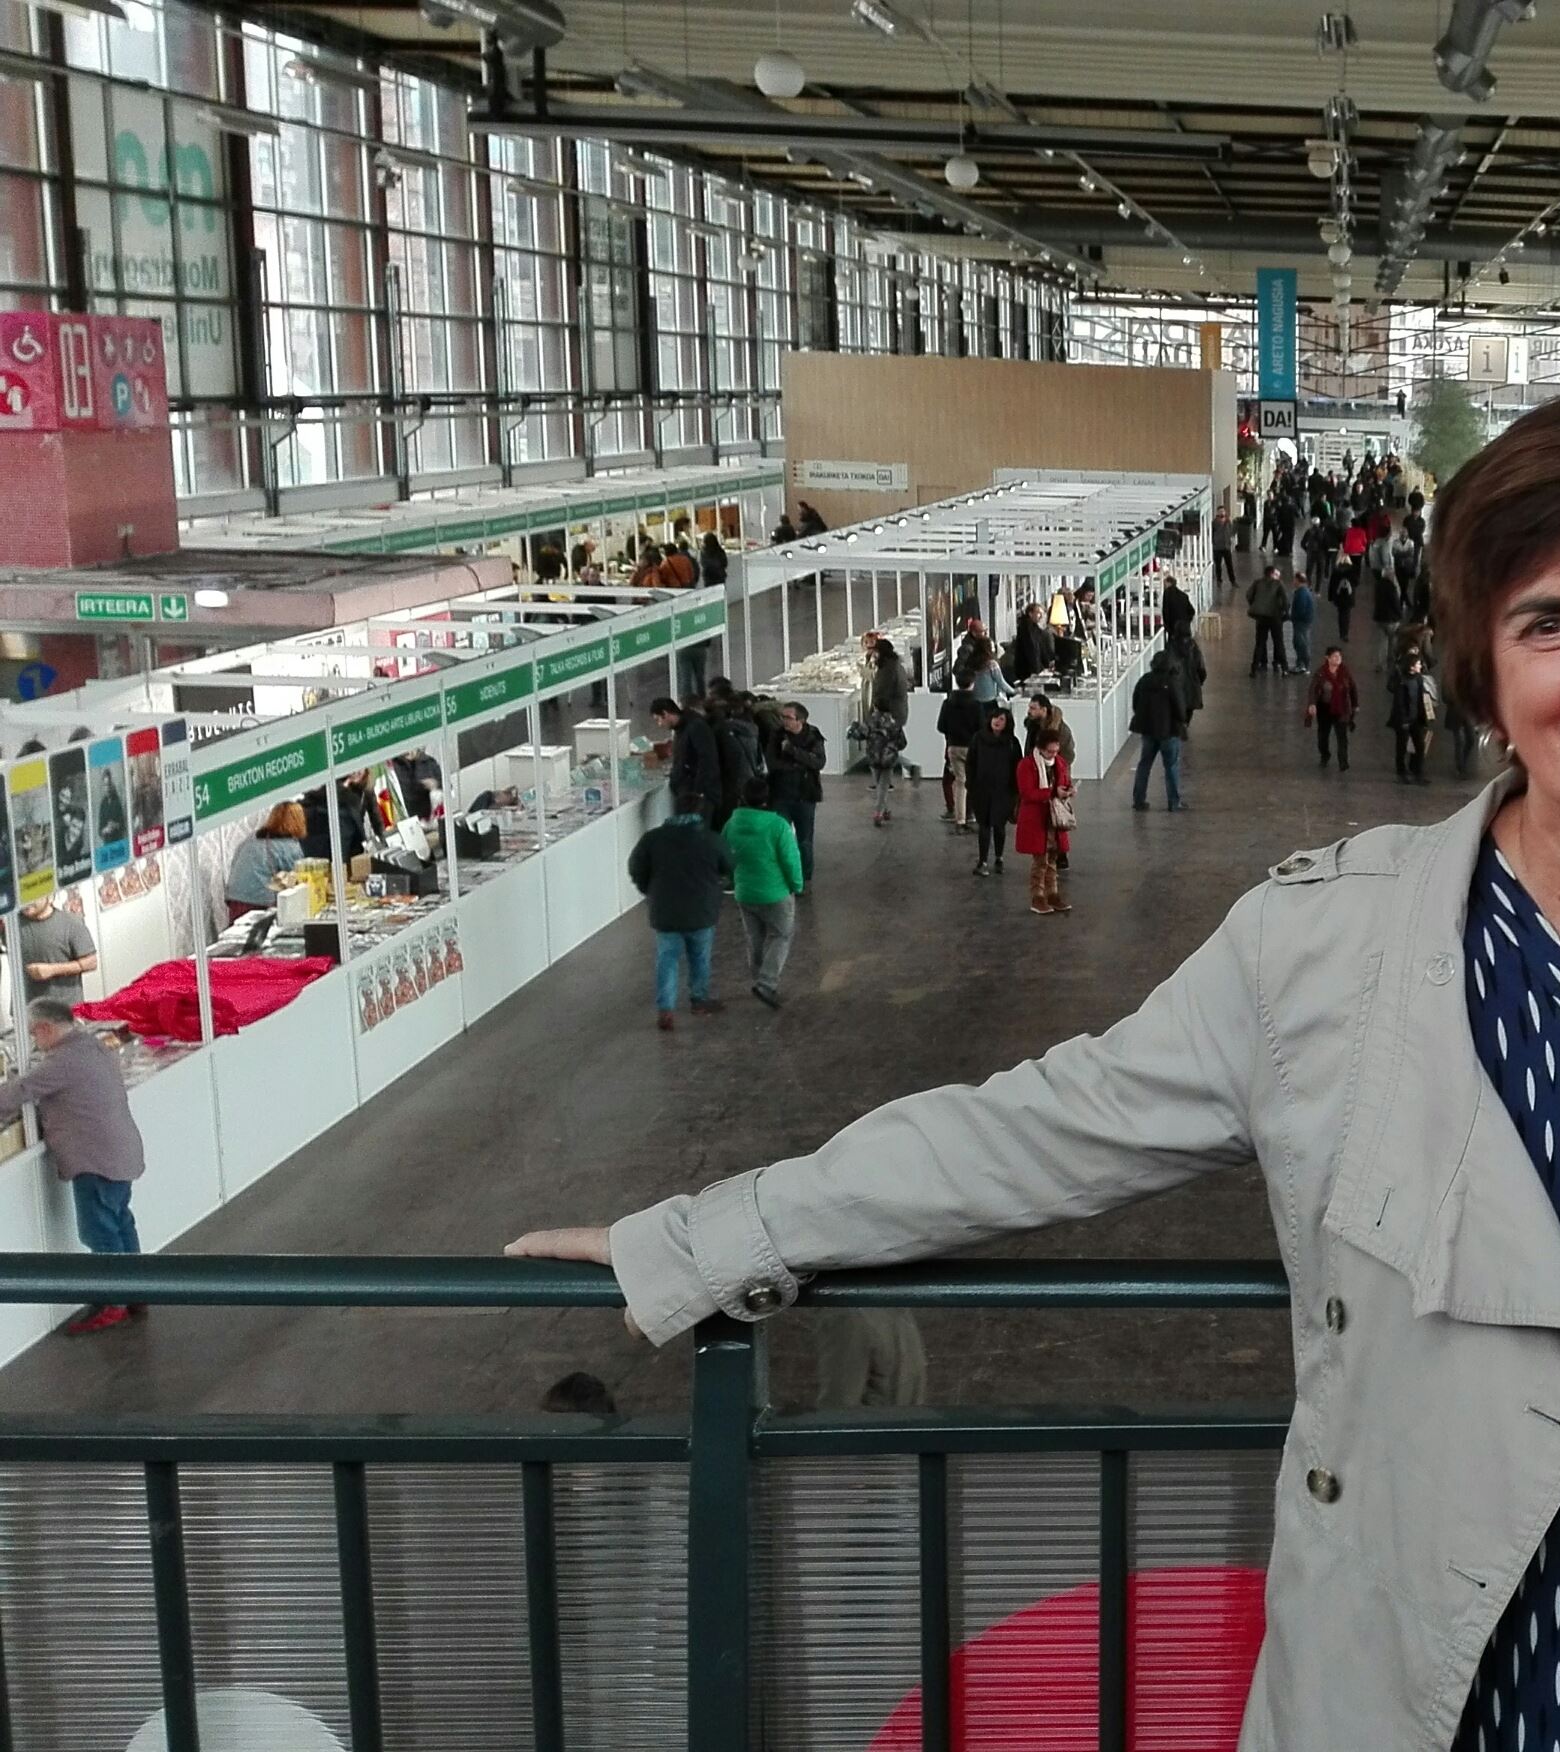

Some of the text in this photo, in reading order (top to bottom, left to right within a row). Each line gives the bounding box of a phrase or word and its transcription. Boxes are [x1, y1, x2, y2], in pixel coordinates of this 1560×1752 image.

[1272, 278, 1285, 375] ARETO NAGUSIA
[1264, 409, 1292, 428] DA!
[80, 598, 149, 615] IRTEERA
[446, 695, 457, 716] 56
[332, 732, 345, 756] 55
[195, 750, 305, 810] 54 BRIXTON RECORDS
